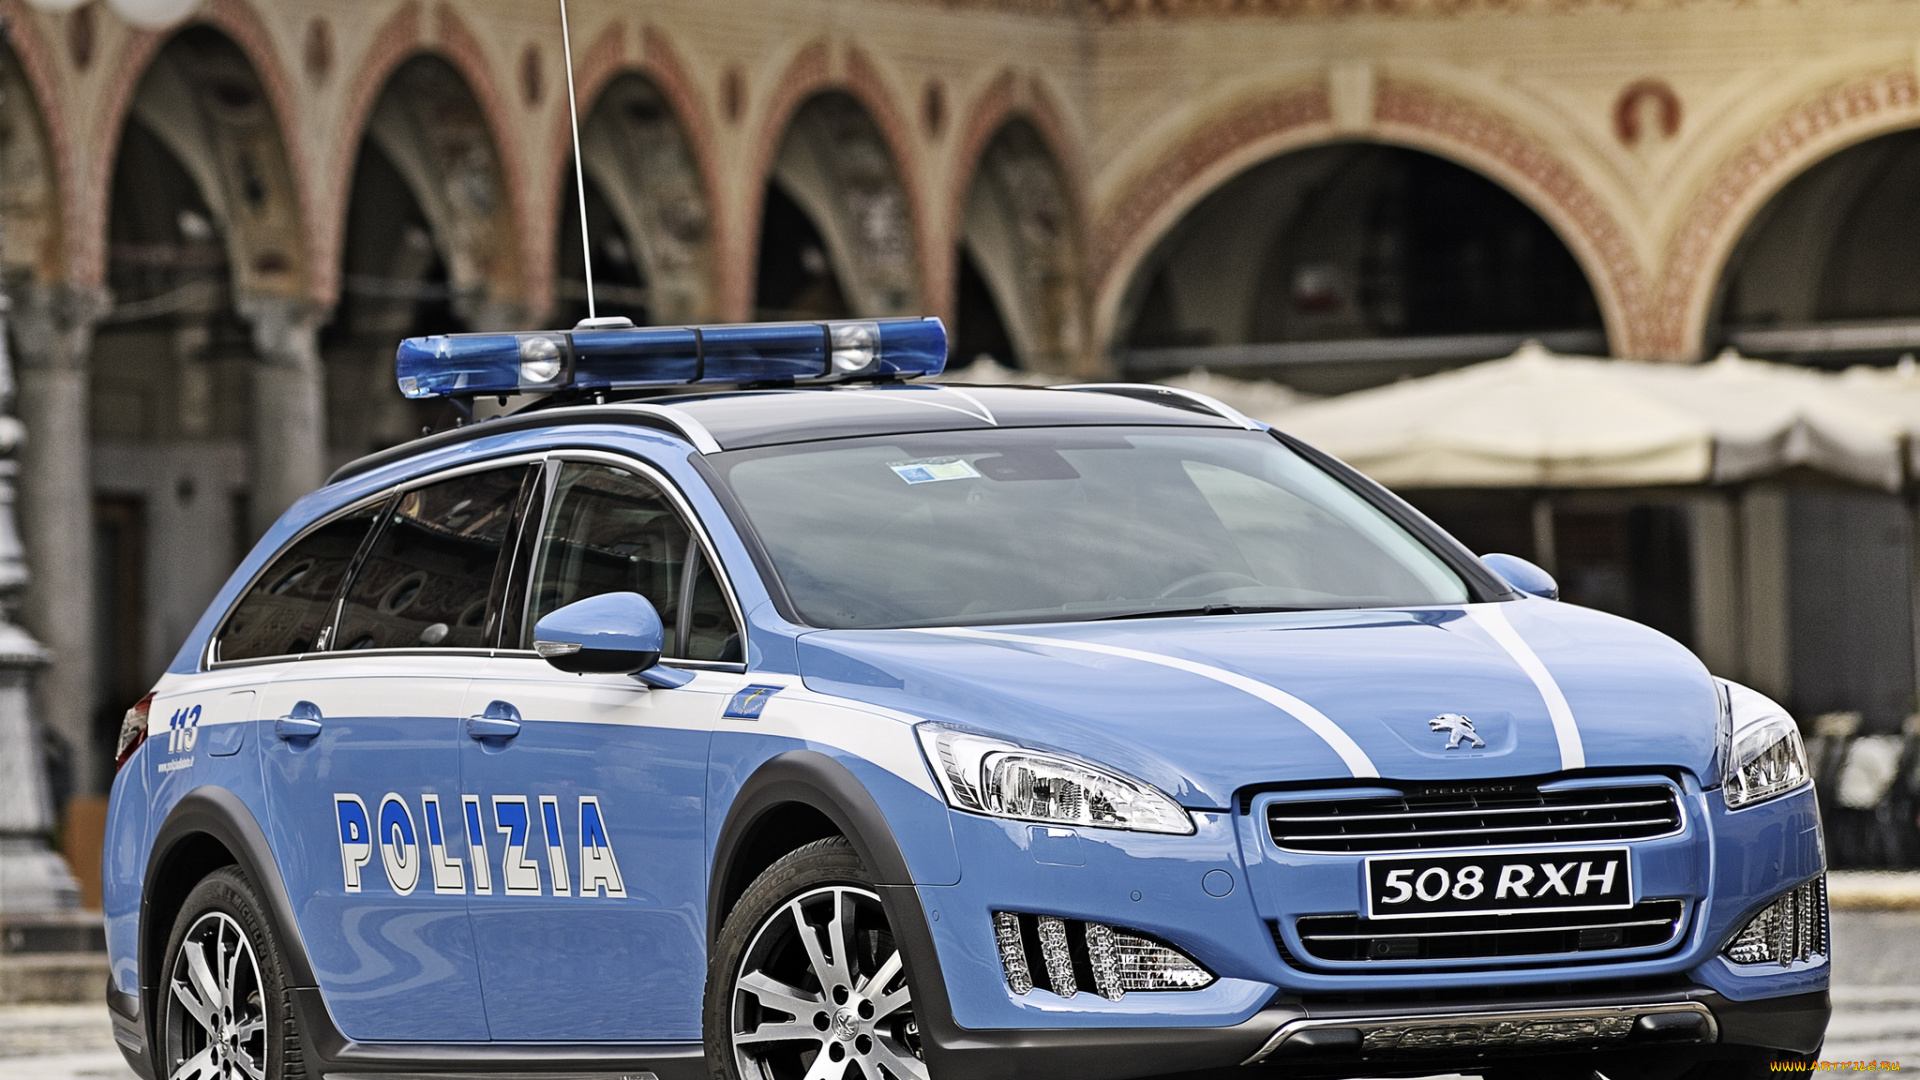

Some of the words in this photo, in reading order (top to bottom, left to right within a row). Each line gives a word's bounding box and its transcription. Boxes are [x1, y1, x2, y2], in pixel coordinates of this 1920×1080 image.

[168, 704, 202, 755] 113
[1425, 785, 1516, 795] PEUGEOT
[333, 792, 628, 899] POLIZIA
[1381, 865, 1485, 904] 508
[1495, 860, 1619, 900] RXH
[232, 894, 267, 958] MICHELIN
